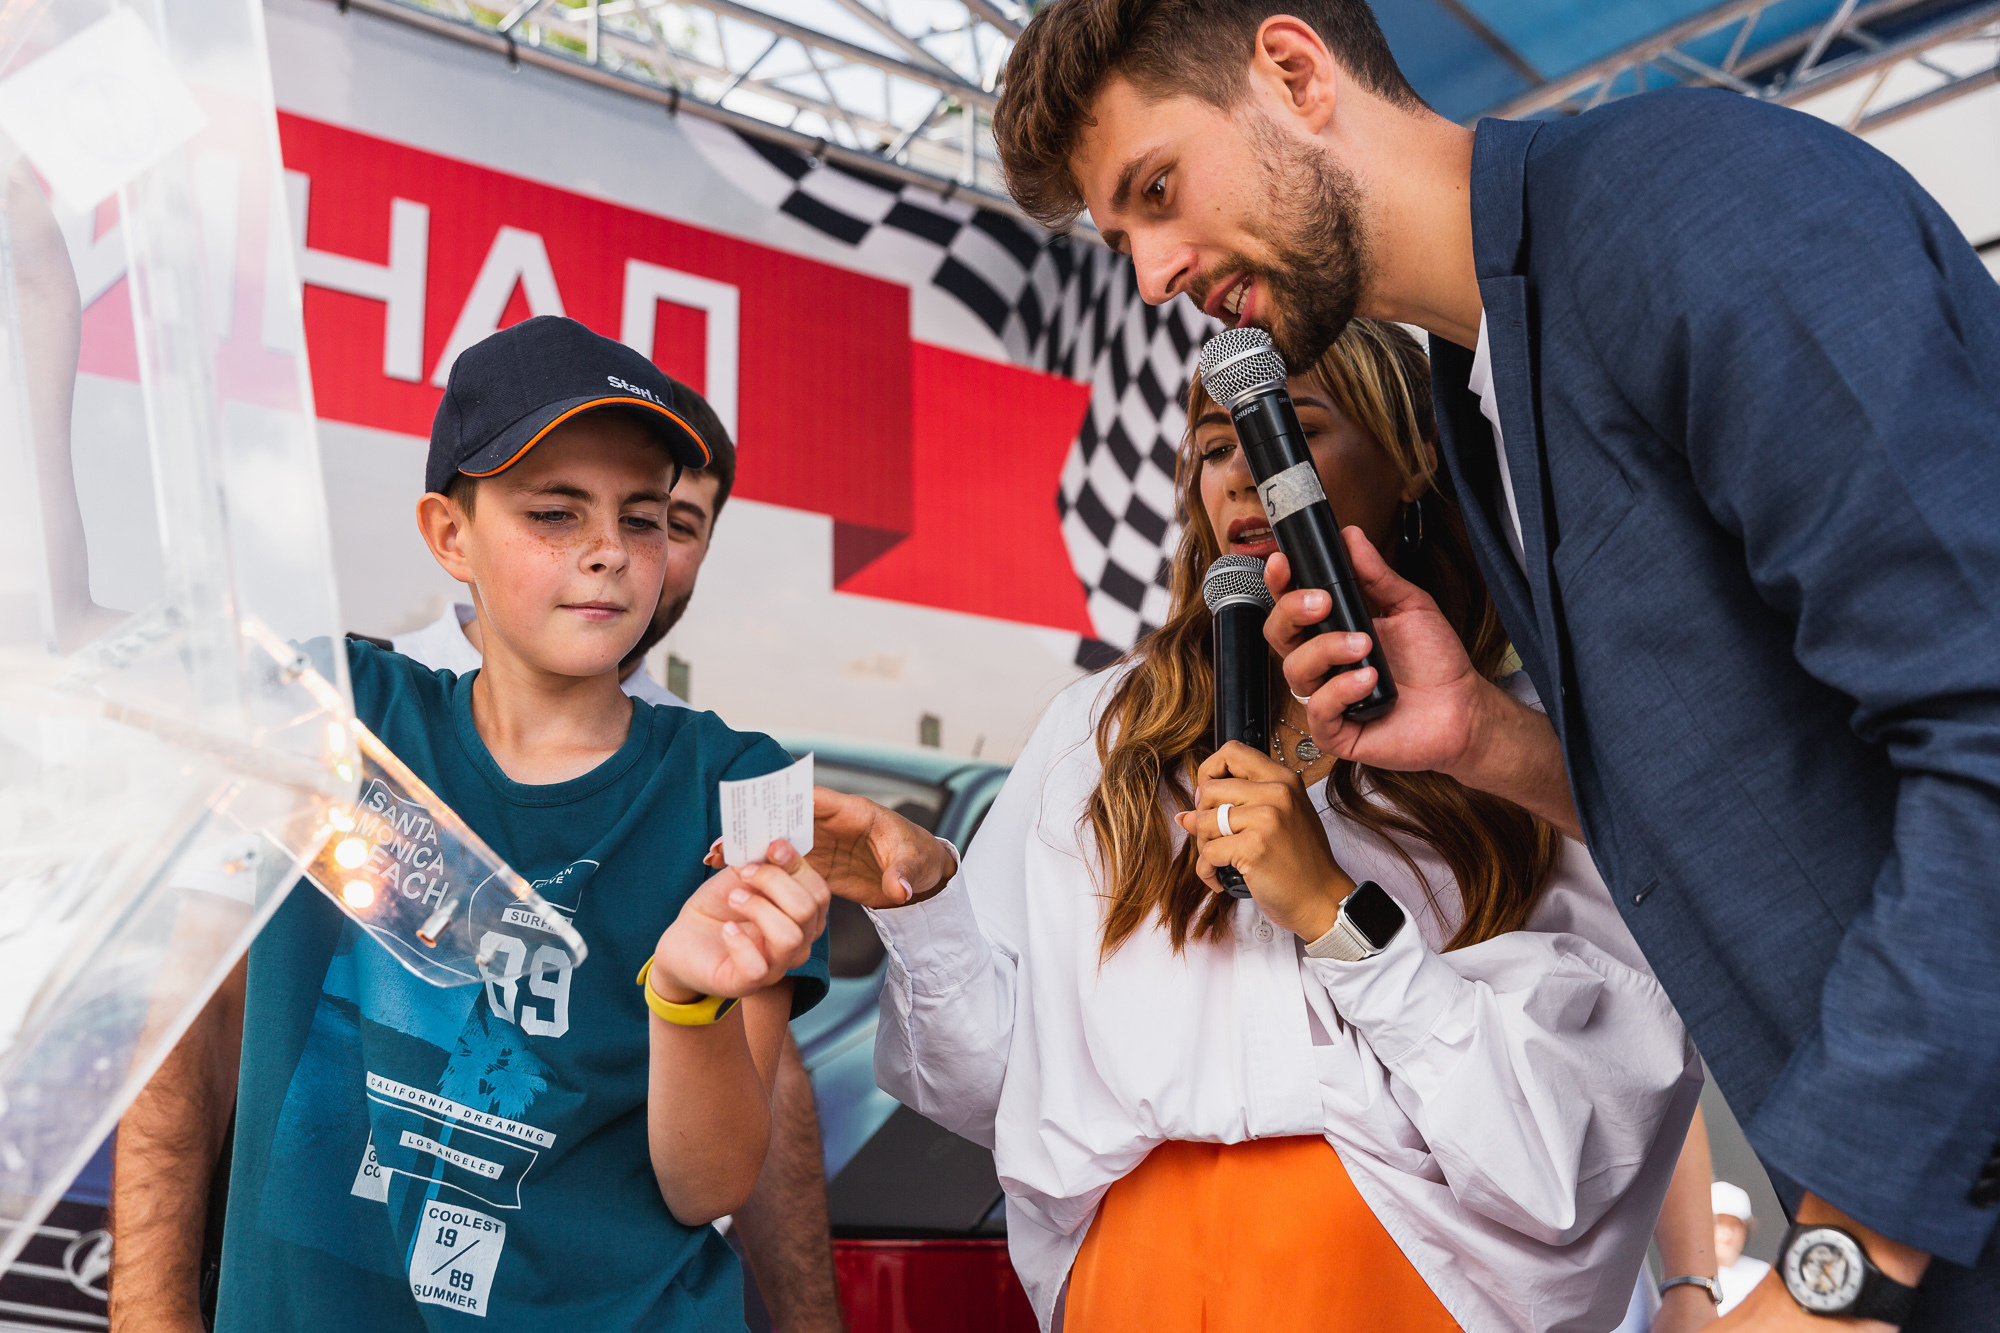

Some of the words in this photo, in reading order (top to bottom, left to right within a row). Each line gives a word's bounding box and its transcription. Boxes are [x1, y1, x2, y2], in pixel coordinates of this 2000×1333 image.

[1265, 483, 1278, 517] 5
[368, 791, 438, 846] SANTA
[354, 812, 444, 876] MONICA
[361, 843, 450, 910] EACH
[478, 930, 574, 1039] 89
[370, 1077, 454, 1113] CALIFORNIA
[463, 1109, 545, 1142] DREAMING
[408, 1136, 432, 1150] LOS
[437, 1147, 496, 1175] ANGELES
[428, 1207, 502, 1234] COOLEST
[435, 1226, 458, 1248] 19
[413, 1284, 478, 1310] SUMMER
[449, 1268, 474, 1292] 89
